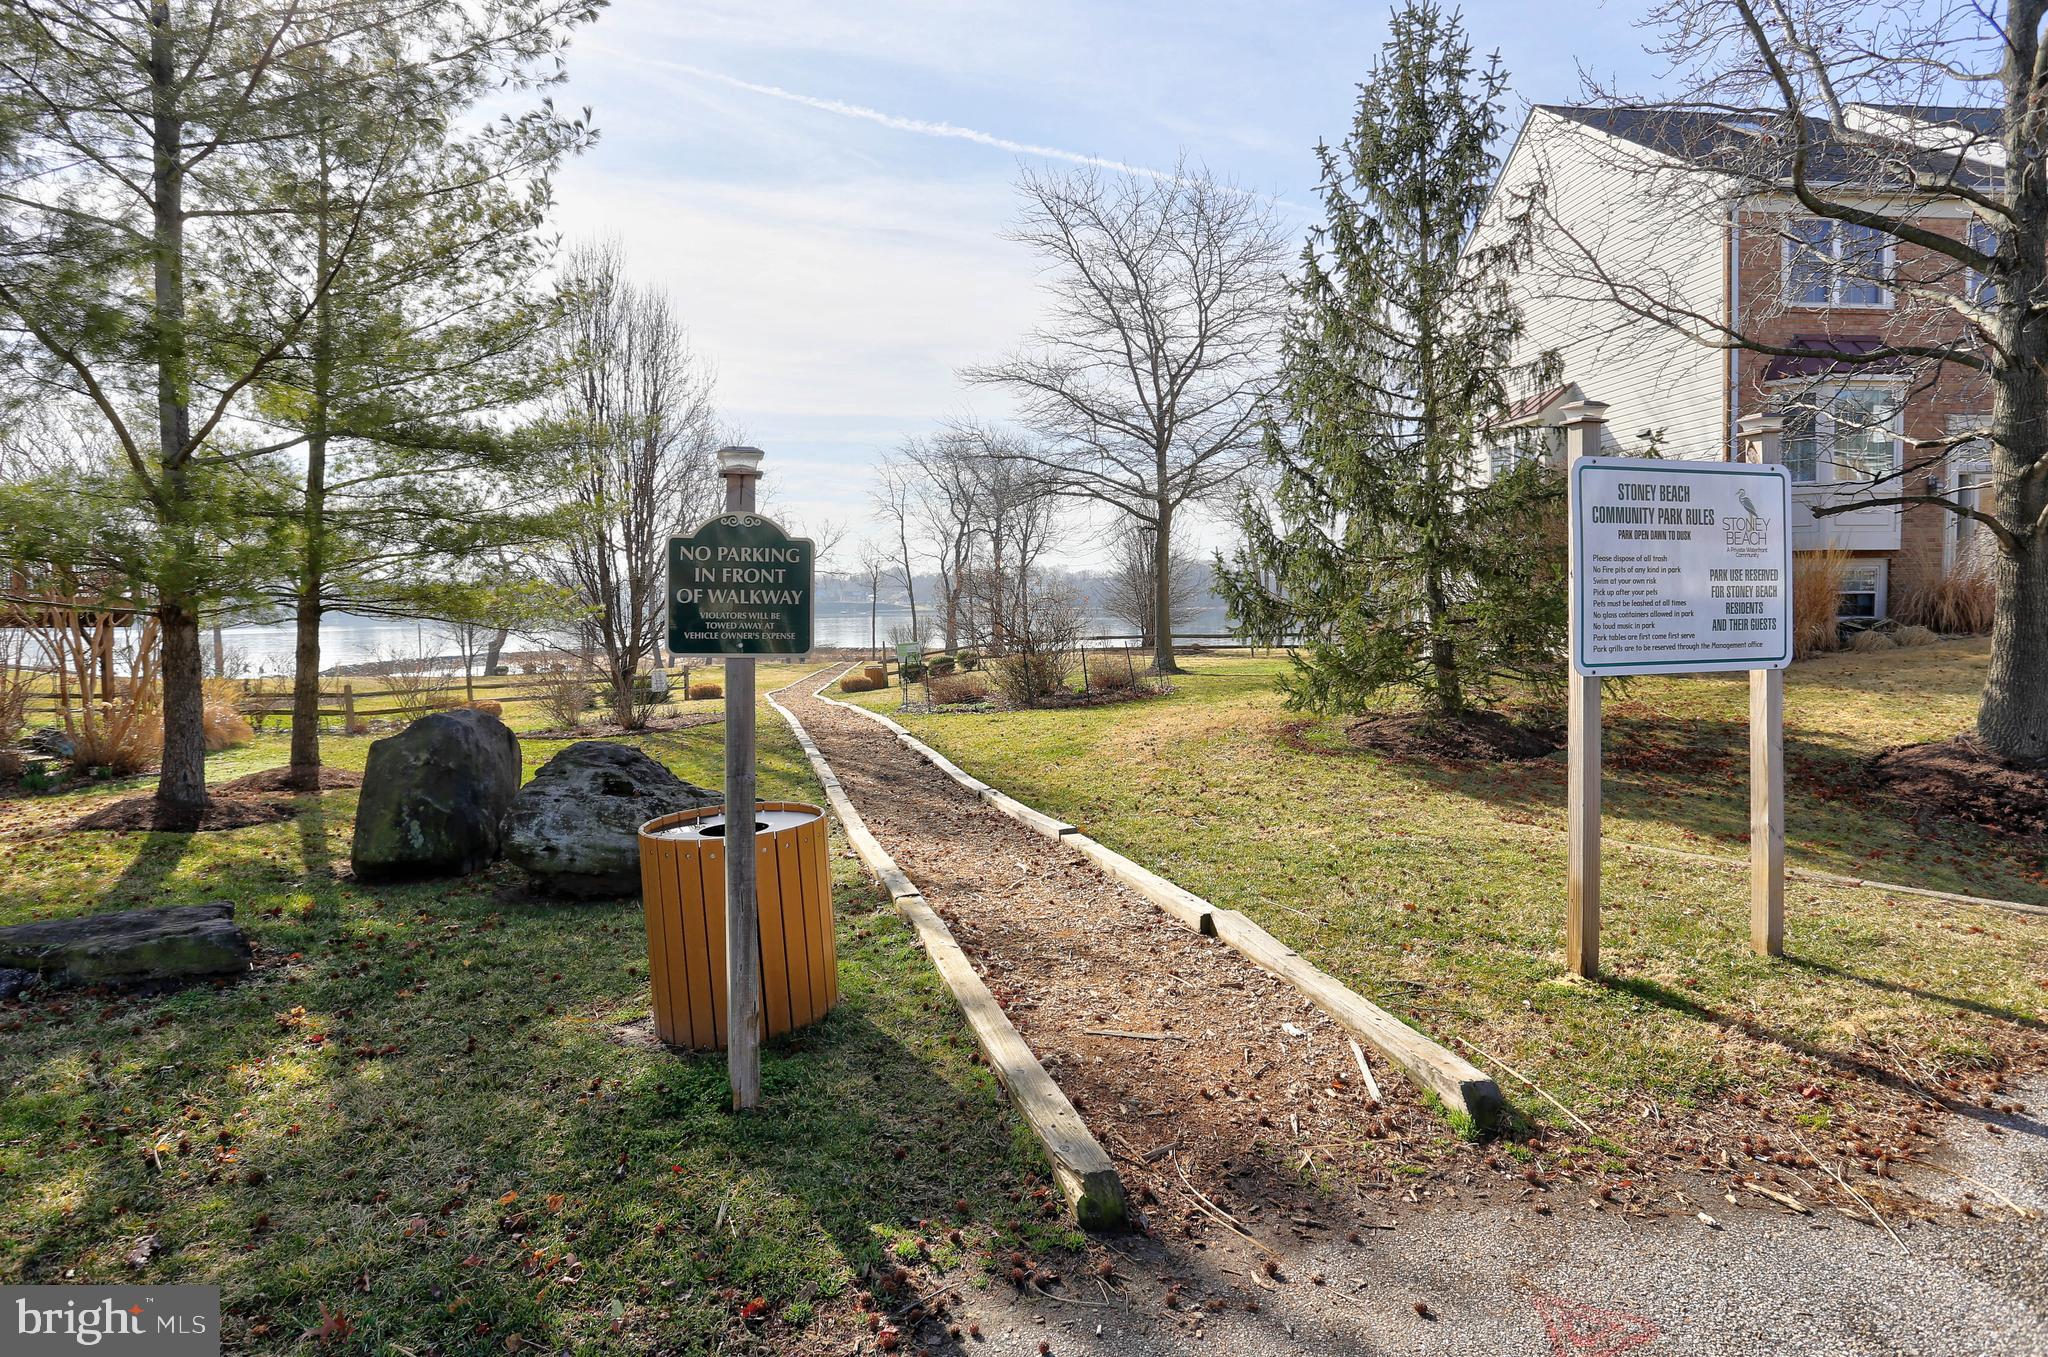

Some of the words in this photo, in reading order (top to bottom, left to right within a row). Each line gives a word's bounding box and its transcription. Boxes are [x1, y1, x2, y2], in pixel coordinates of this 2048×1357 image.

[1618, 483, 1656, 501] STONEY
[1660, 485, 1690, 502] BEACH
[1592, 506, 1654, 524] COMMUNITY
[1658, 508, 1682, 524] PARK
[1686, 509, 1714, 525] RULES
[1723, 518, 1770, 531] STONEY
[1618, 530, 1632, 539] PARK
[1634, 530, 1648, 539] OPEN
[1651, 530, 1666, 540] DAWN
[1668, 531, 1675, 540] TO
[1677, 531, 1691, 540] DUSK
[1727, 532, 1766, 545] BEACH
[680, 546, 711, 560] NO
[718, 546, 800, 563] PARKING
[695, 568, 715, 582] IN
[722, 568, 786, 583] FRONT
[1710, 569, 1727, 581] PARK
[1730, 569, 1743, 581] USE
[1745, 569, 1778, 581] RESERVED
[676, 588, 703, 604] OF
[708, 589, 803, 604] WALKWAY
[1712, 586, 1724, 598] FOR
[1727, 586, 1753, 598] STONEY
[1756, 586, 1777, 597] BEACH
[1726, 602, 1763, 614] RESIDENTS
[748, 612, 768, 620] WILL
[771, 612, 780, 620] BE
[1712, 619, 1726, 631] AND
[1729, 619, 1748, 630] THEIR
[1751, 618, 1776, 630] GUESTS
[721, 632, 759, 640] OWNER'S
[762, 632, 795, 640] EXPENSE
[1609, 645, 1623, 653] grills
[1678, 642, 1699, 651] through
[1711, 641, 1746, 649] Management
